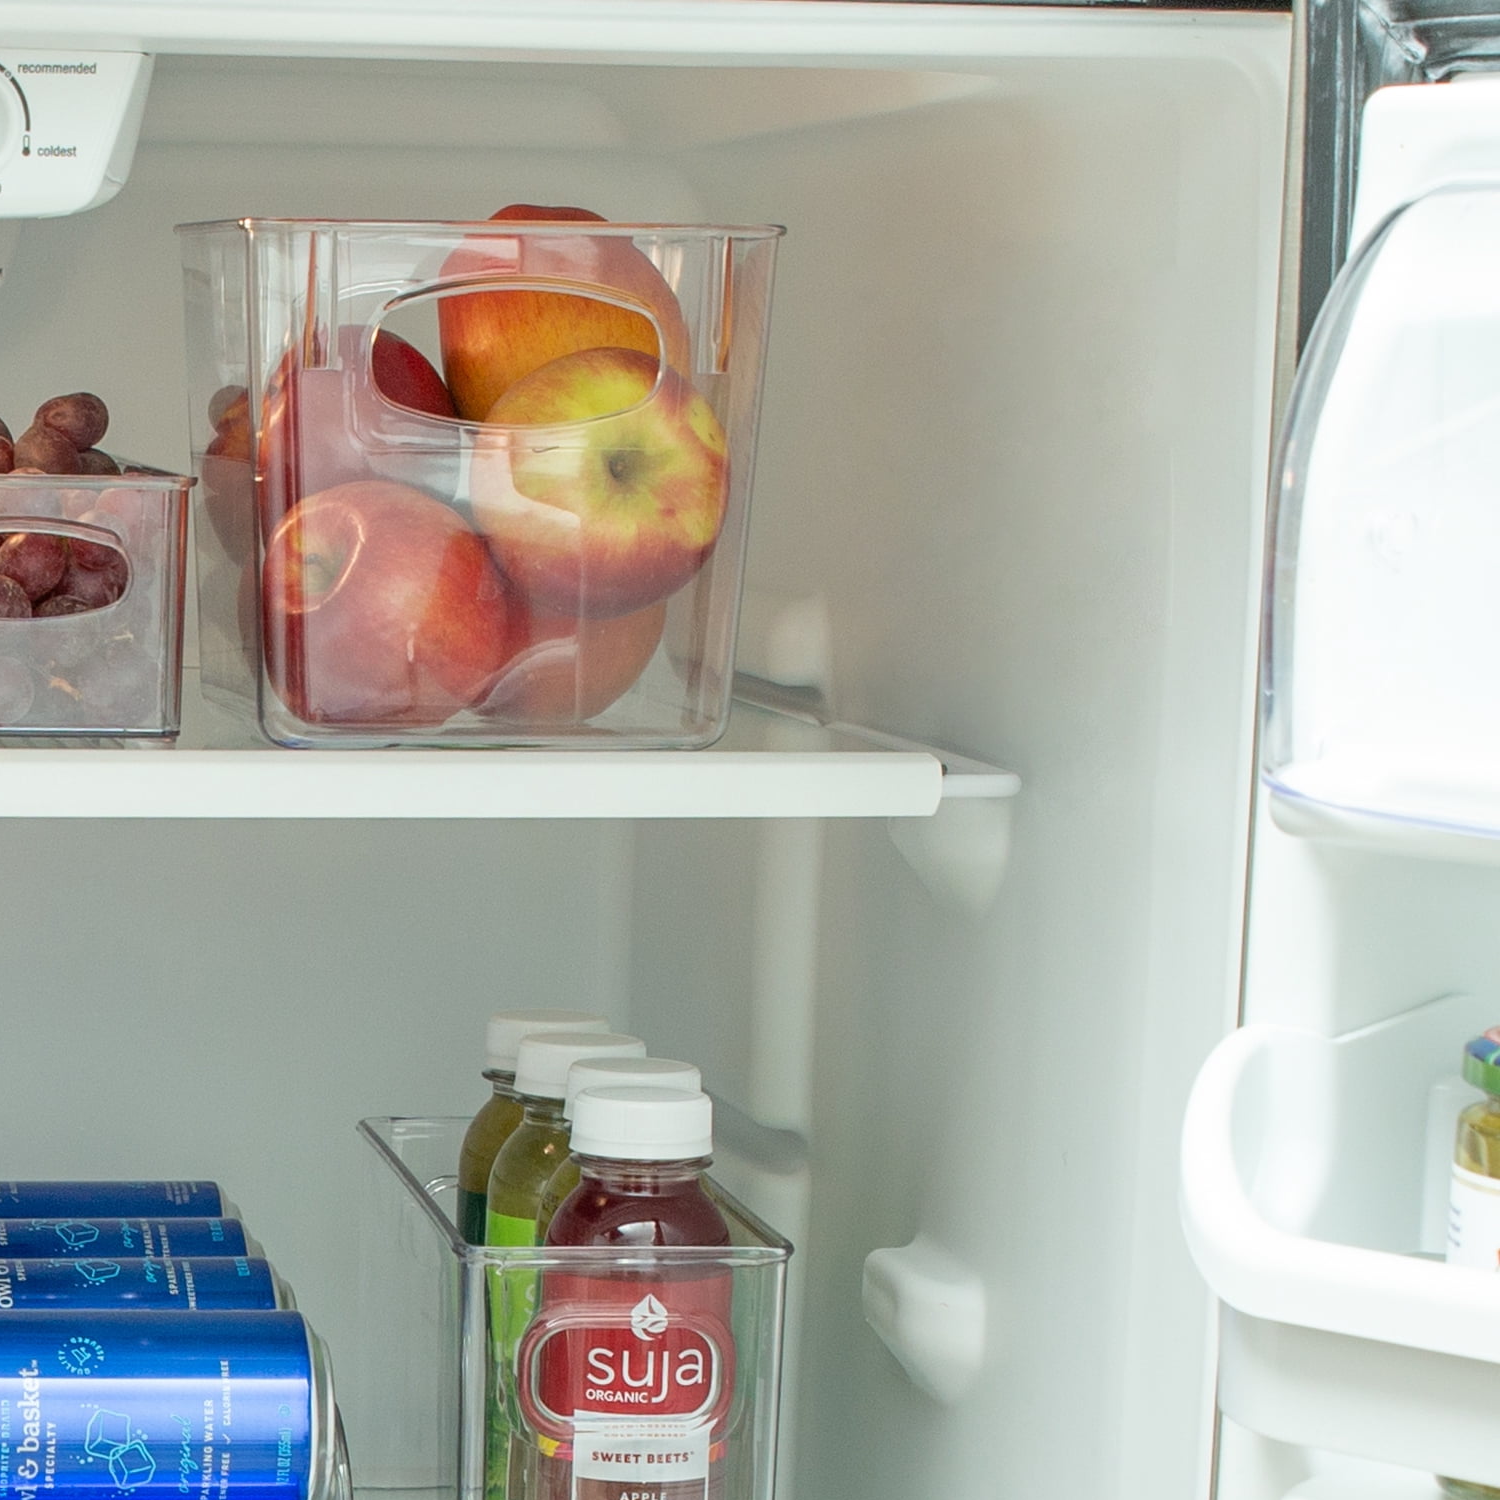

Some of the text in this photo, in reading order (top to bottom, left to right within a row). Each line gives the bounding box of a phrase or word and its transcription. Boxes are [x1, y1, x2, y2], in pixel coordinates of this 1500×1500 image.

[17, 61, 97, 75] recommended
[37, 146, 77, 158] coldest
[585, 1388, 648, 1403] ORGANIC
[586, 1347, 705, 1404] suja
[17, 1367, 41, 1480] & basket
[203, 1399, 214, 1442] WATER
[45, 1421, 57, 1489] SPECIALTY
[170, 1414, 199, 1494] original
[592, 1451, 690, 1464] SWEET BEETS
